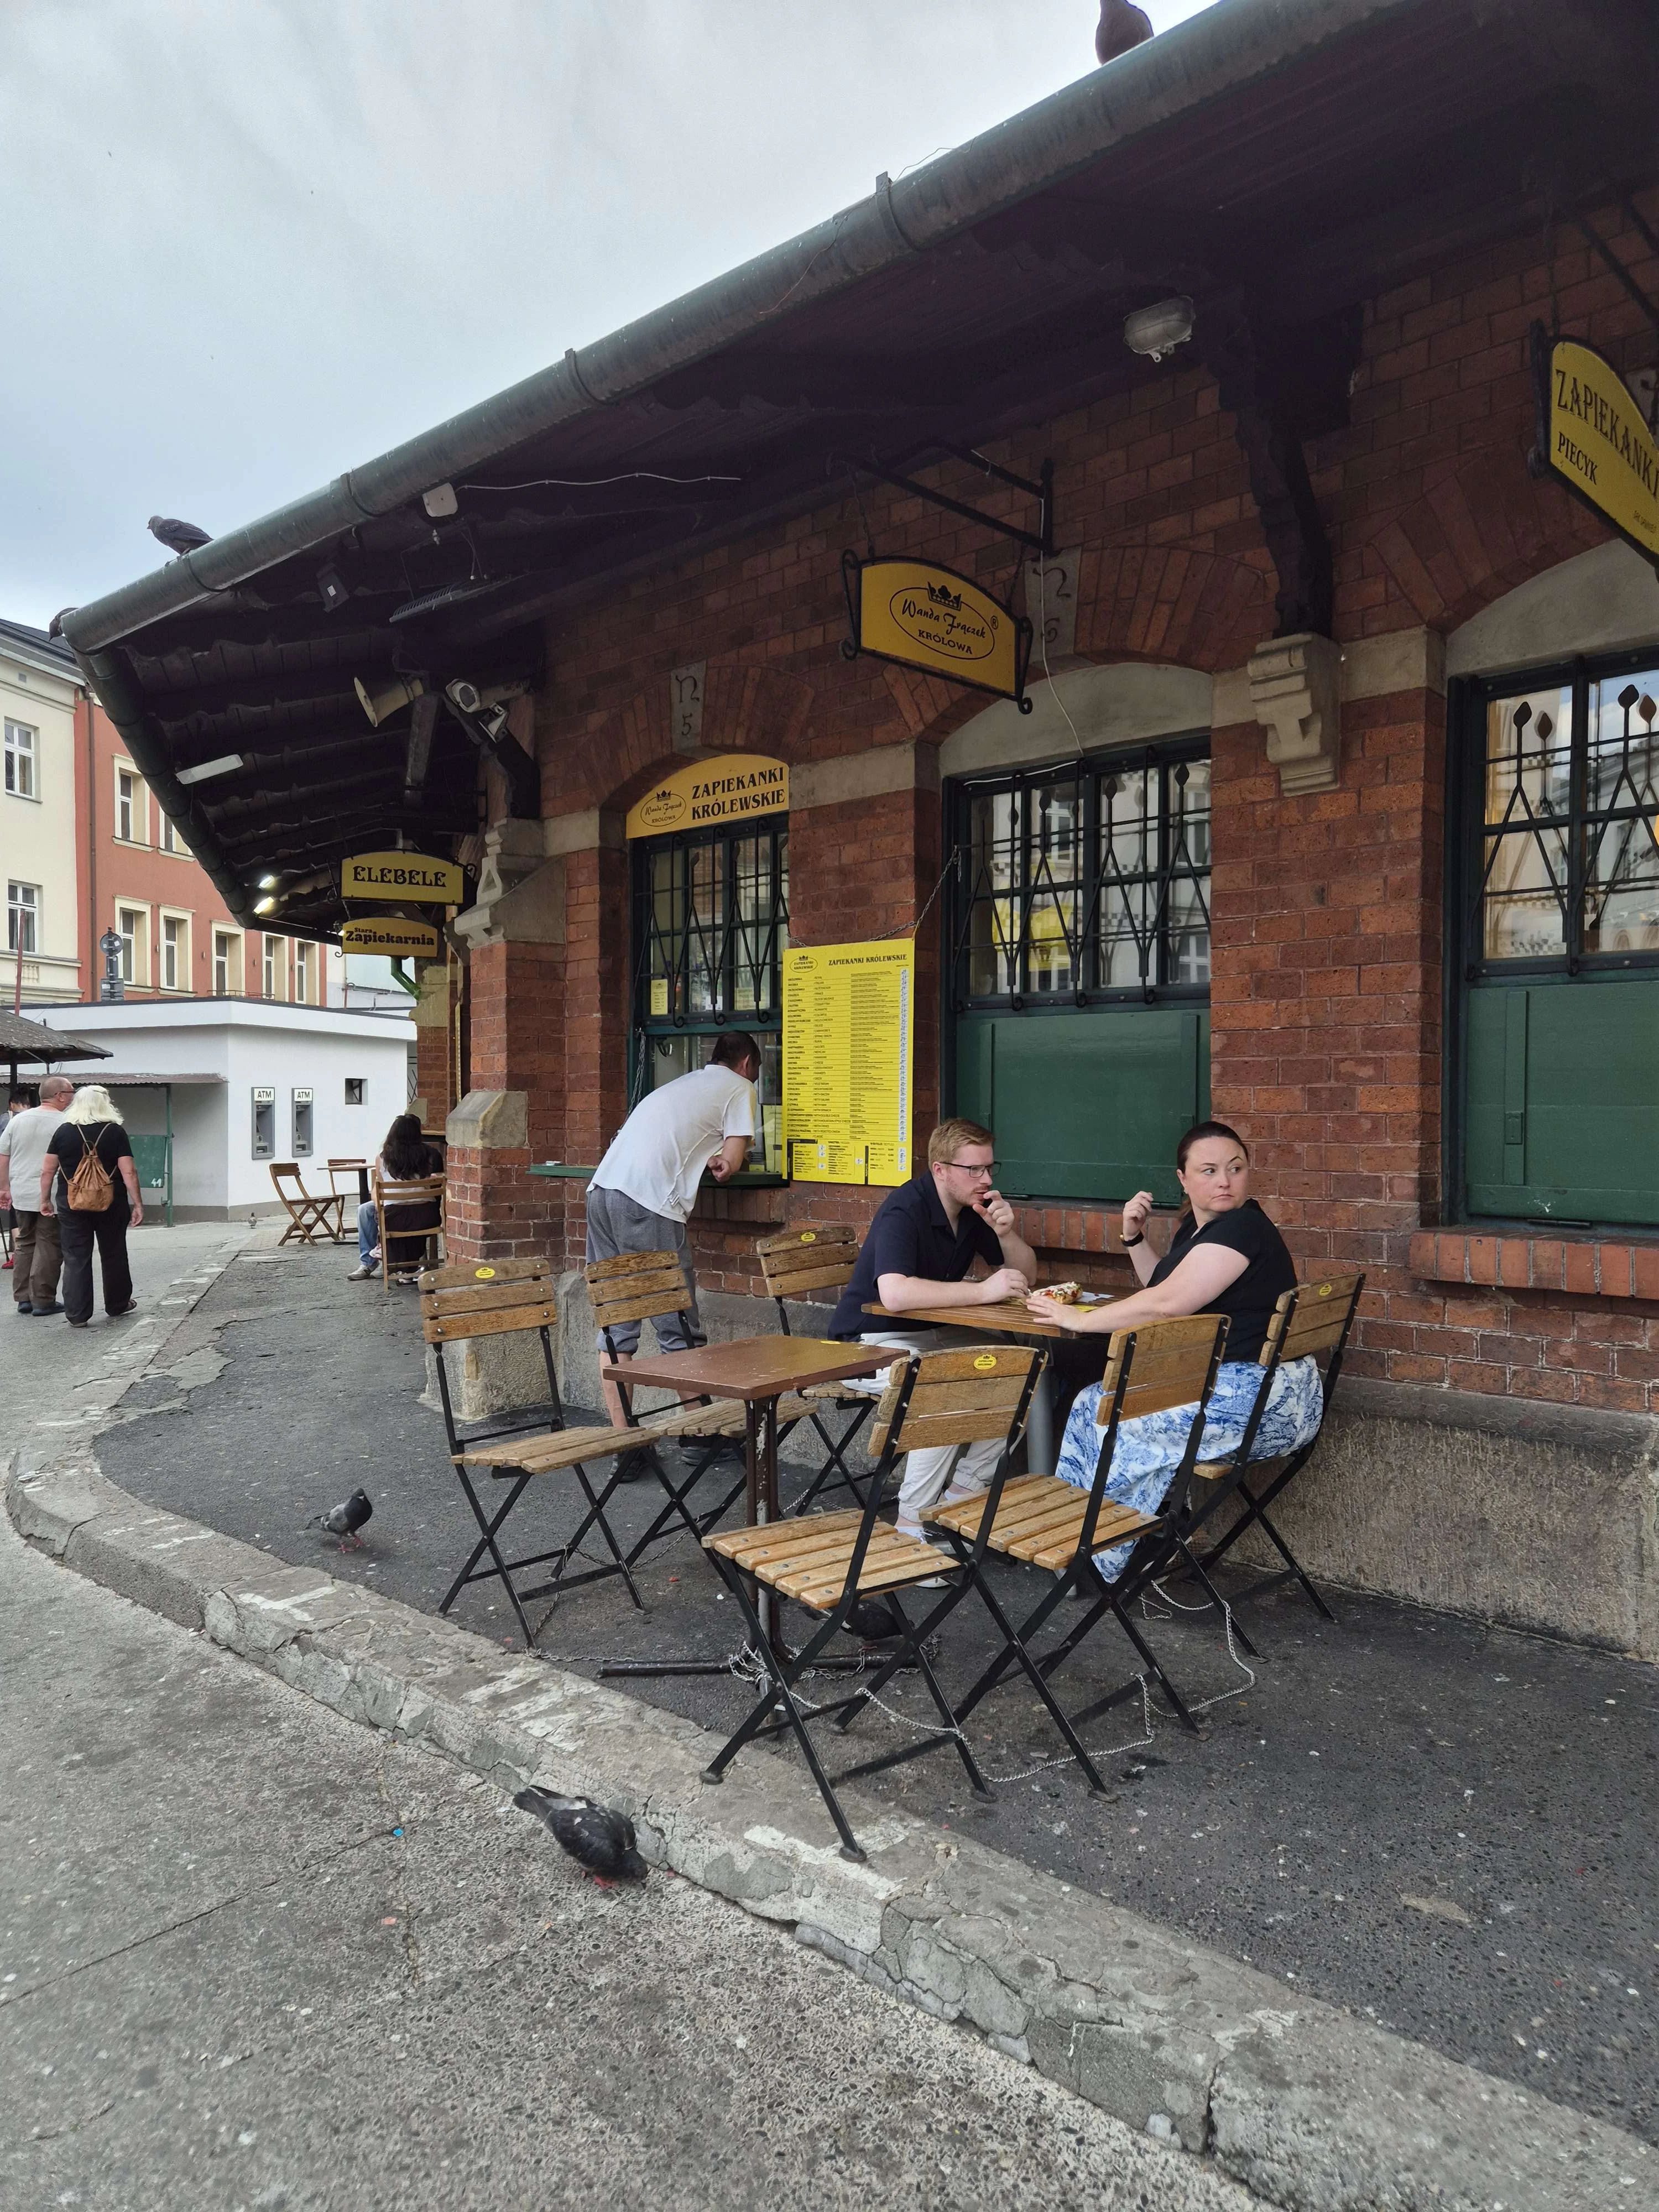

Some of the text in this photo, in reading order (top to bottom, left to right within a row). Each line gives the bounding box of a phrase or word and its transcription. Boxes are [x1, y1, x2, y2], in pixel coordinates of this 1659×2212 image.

[1555, 369, 1659, 500] ZAPIEKANKI
[1557, 431, 1597, 486] PIECYK
[901, 598, 987, 639] Wanda Frączek
[917, 629, 973, 655] KRÓLOWA
[681, 713, 693, 736] 5
[692, 766, 784, 800] ZAPIEKANKI
[692, 789, 785, 820] KRÓLEWSKIE
[352, 865, 447, 887] ELEBELE
[346, 931, 435, 945] Zapiekarnia
[828, 954, 907, 966] ZAPIEKANKI KRÓLEWSKIE
